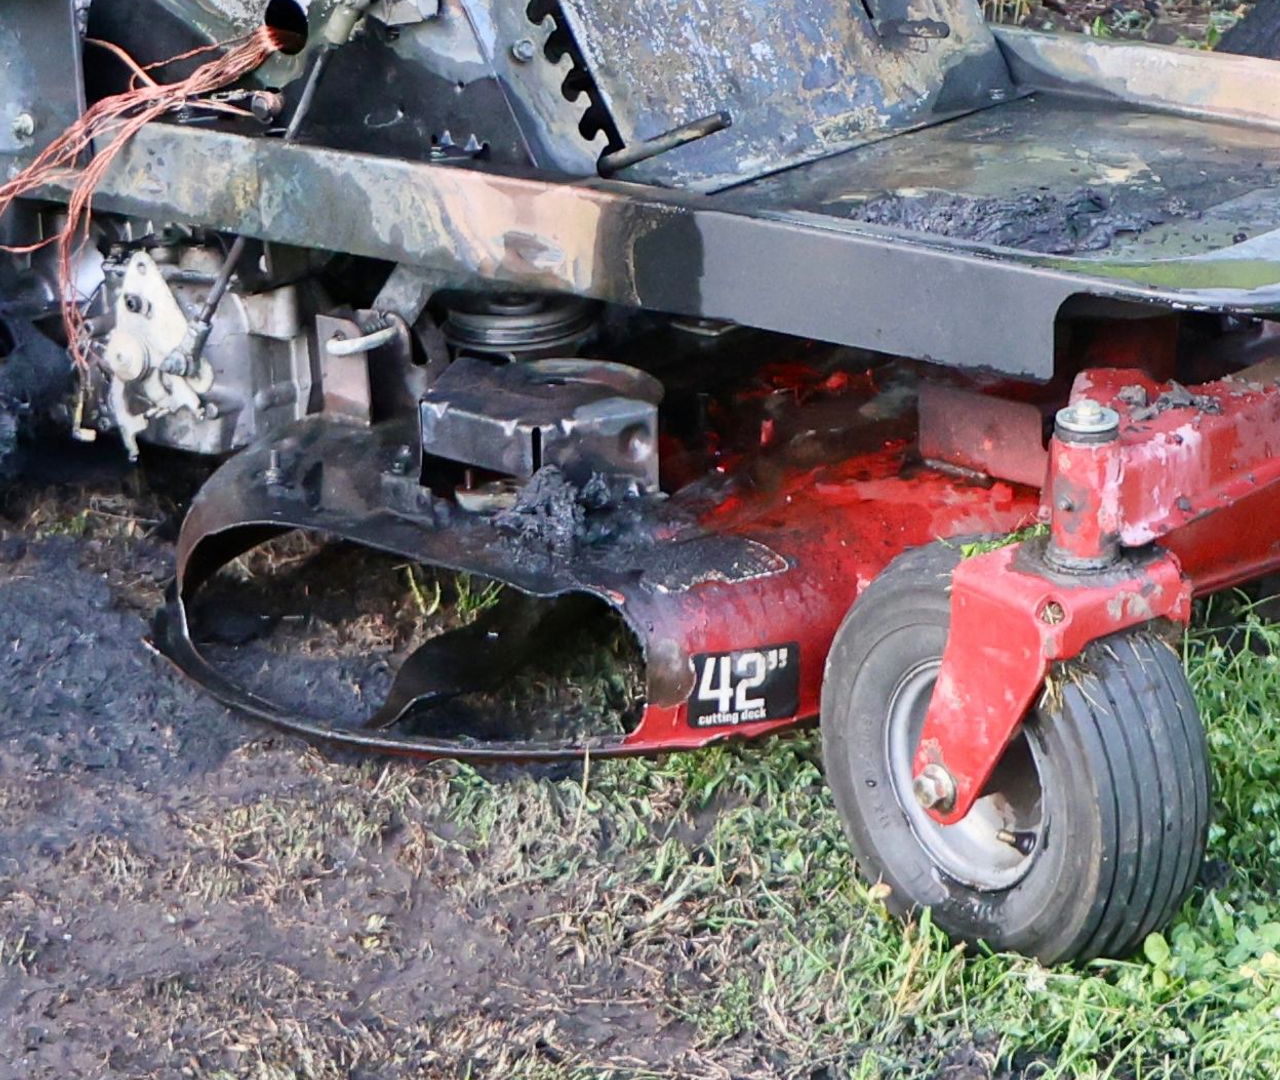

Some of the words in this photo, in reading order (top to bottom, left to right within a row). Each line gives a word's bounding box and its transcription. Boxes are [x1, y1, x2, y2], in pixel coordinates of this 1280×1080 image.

[698, 647, 788, 712] 42"
[698, 711, 738, 725] cutting
[741, 706, 767, 720] deck
